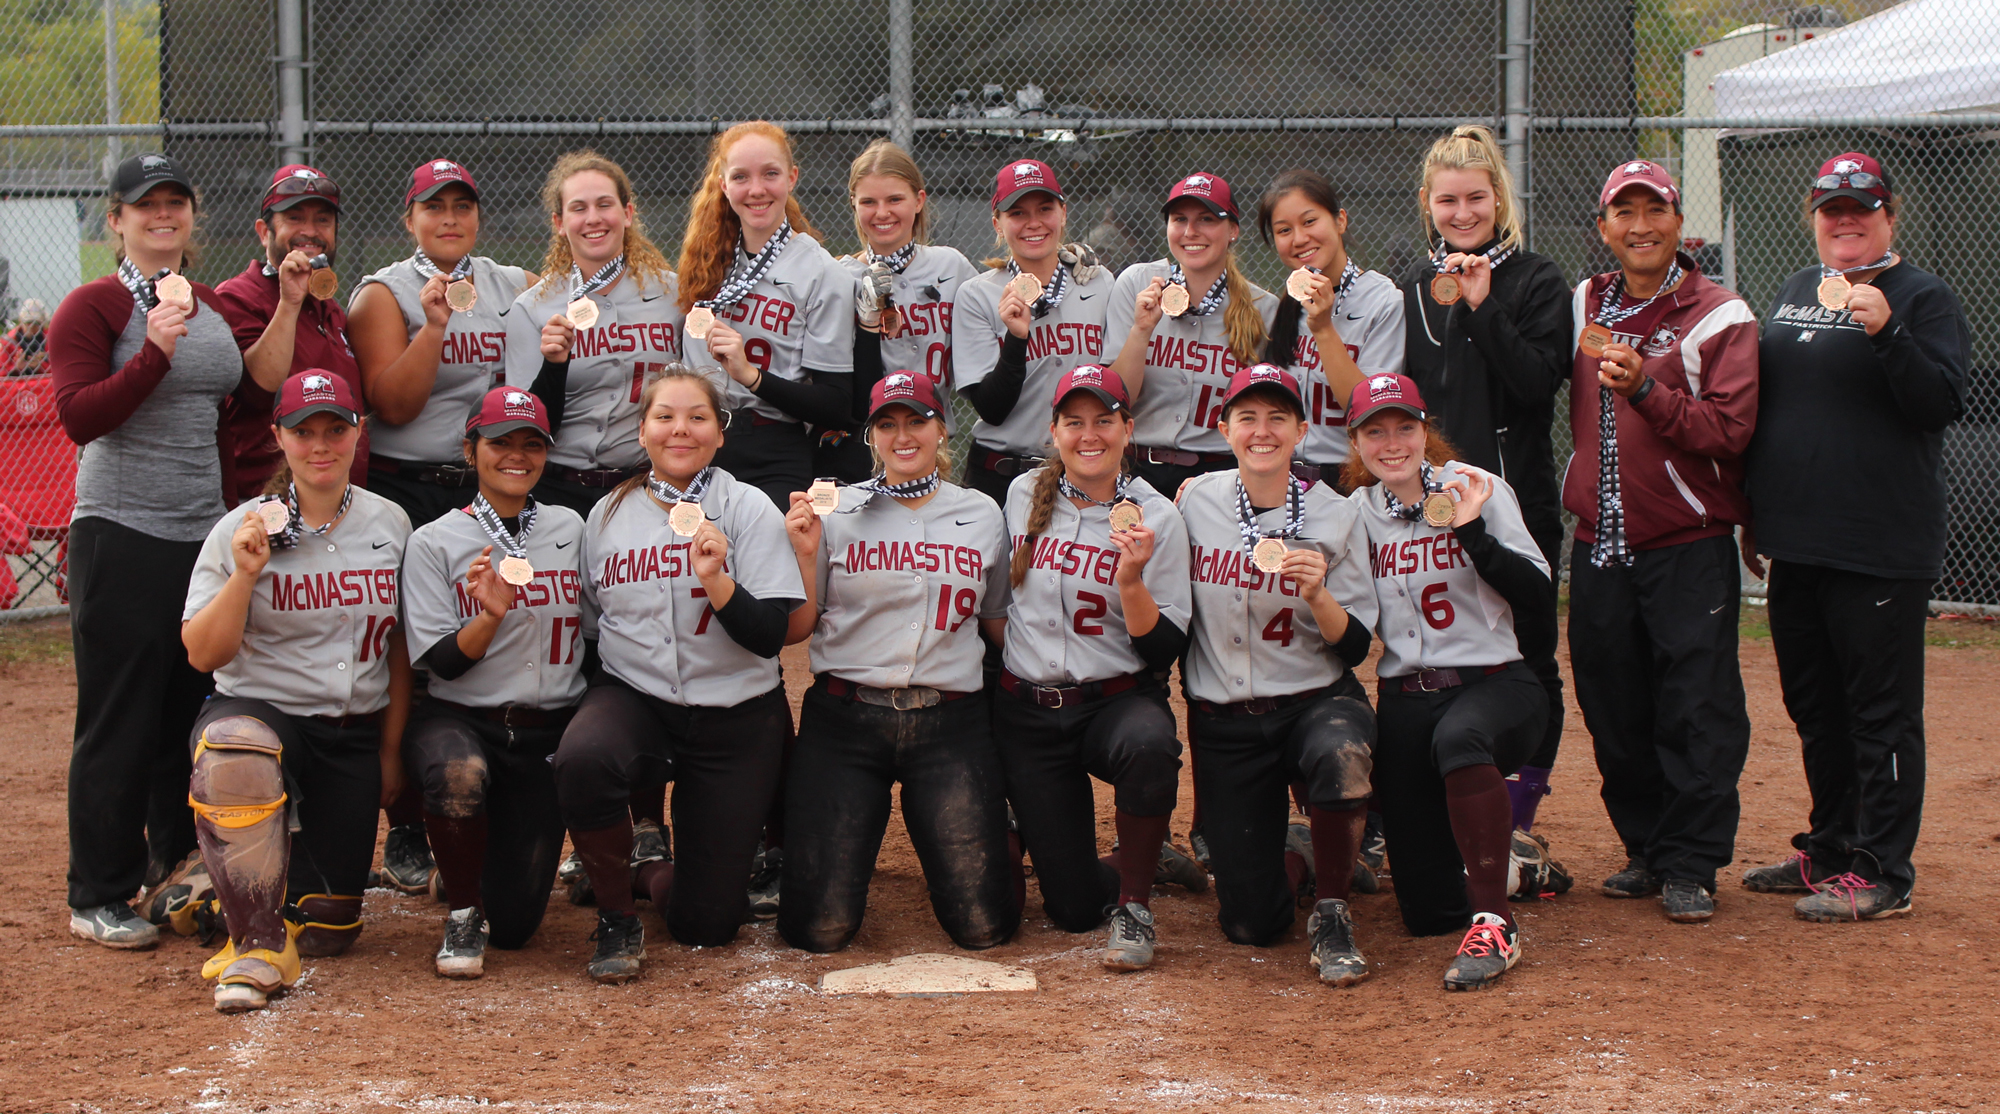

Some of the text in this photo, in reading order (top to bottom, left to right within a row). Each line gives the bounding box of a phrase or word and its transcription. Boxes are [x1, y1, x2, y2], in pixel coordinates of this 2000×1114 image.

[1772, 303, 1867, 326] McMAST
[1791, 321, 1835, 330] FASTPITCH
[570, 322, 677, 360] MASTER
[846, 540, 983, 583] McMASTER
[271, 568, 398, 612] McMASTER
[456, 569, 583, 619] MASTER
[690, 587, 715, 636] 7
[934, 583, 978, 633] 19
[1421, 582, 1456, 631] 6
[1073, 590, 1108, 636] 2
[1261, 607, 1295, 648] 4
[549, 616, 581, 665] 17
[219, 808, 266, 819] EASTON
